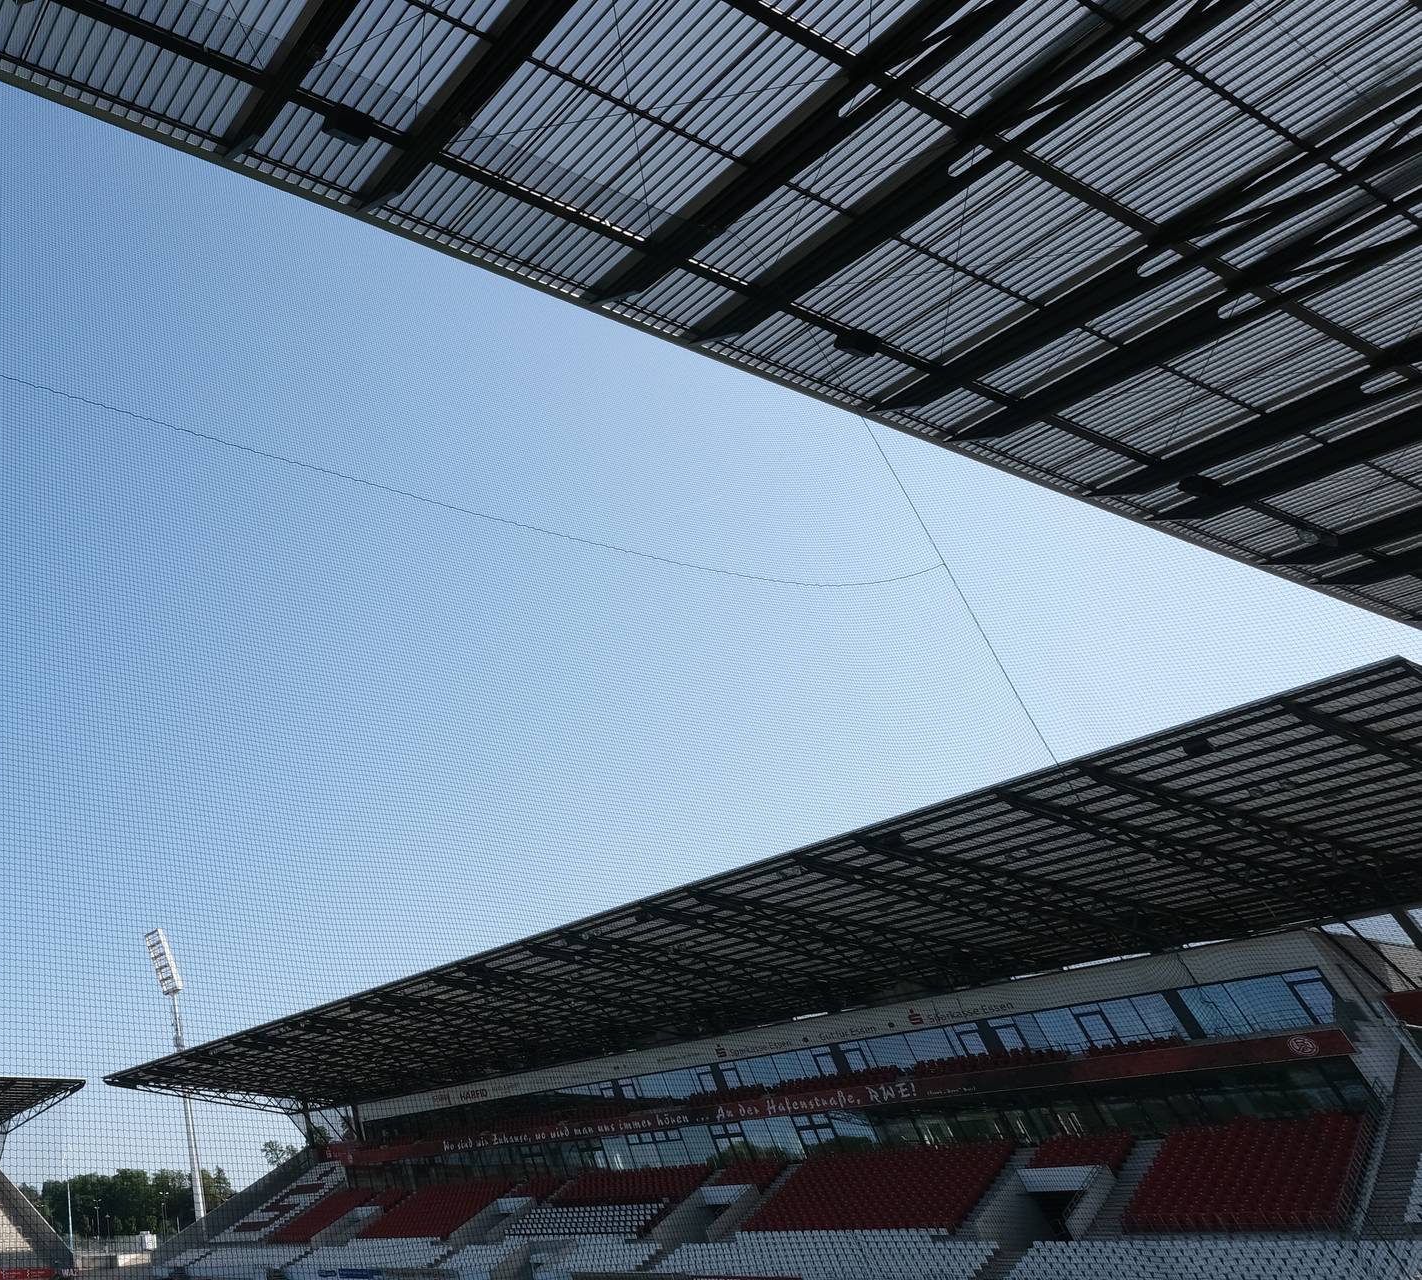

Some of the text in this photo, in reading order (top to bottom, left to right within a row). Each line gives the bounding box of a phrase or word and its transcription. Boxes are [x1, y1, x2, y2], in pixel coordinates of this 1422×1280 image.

[927, 1008, 979, 1024] Sparkasse
[982, 1002, 1014, 1014] Essen
[573, 1126, 594, 1135] man
[597, 1123, 615, 1133] uns
[618, 1119, 652, 1131] immer
[656, 1113, 690, 1127] hören
[738, 1103, 760, 1117] der
[865, 1082, 917, 1104] RWE!
